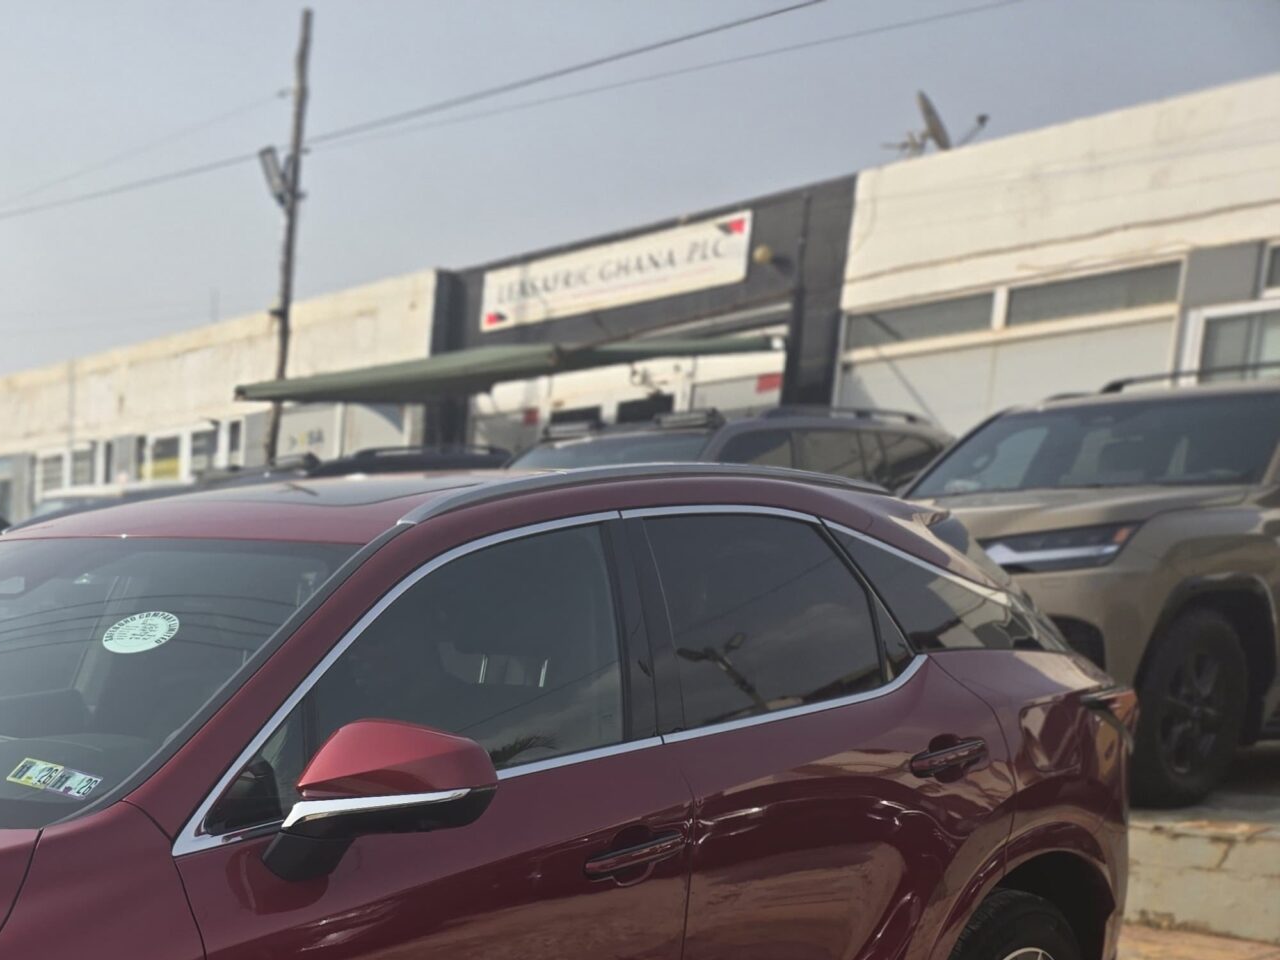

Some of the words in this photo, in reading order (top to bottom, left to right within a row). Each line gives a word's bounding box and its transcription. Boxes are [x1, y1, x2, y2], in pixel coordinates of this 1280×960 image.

[598, 250, 677, 284] GHANA
[685, 237, 728, 265] PLC
[138, 612, 177, 623] COMPANY
[154, 622, 178, 644] LIMITED
[38, 767, 59, 784] 26
[76, 778, 98, 795] 26
